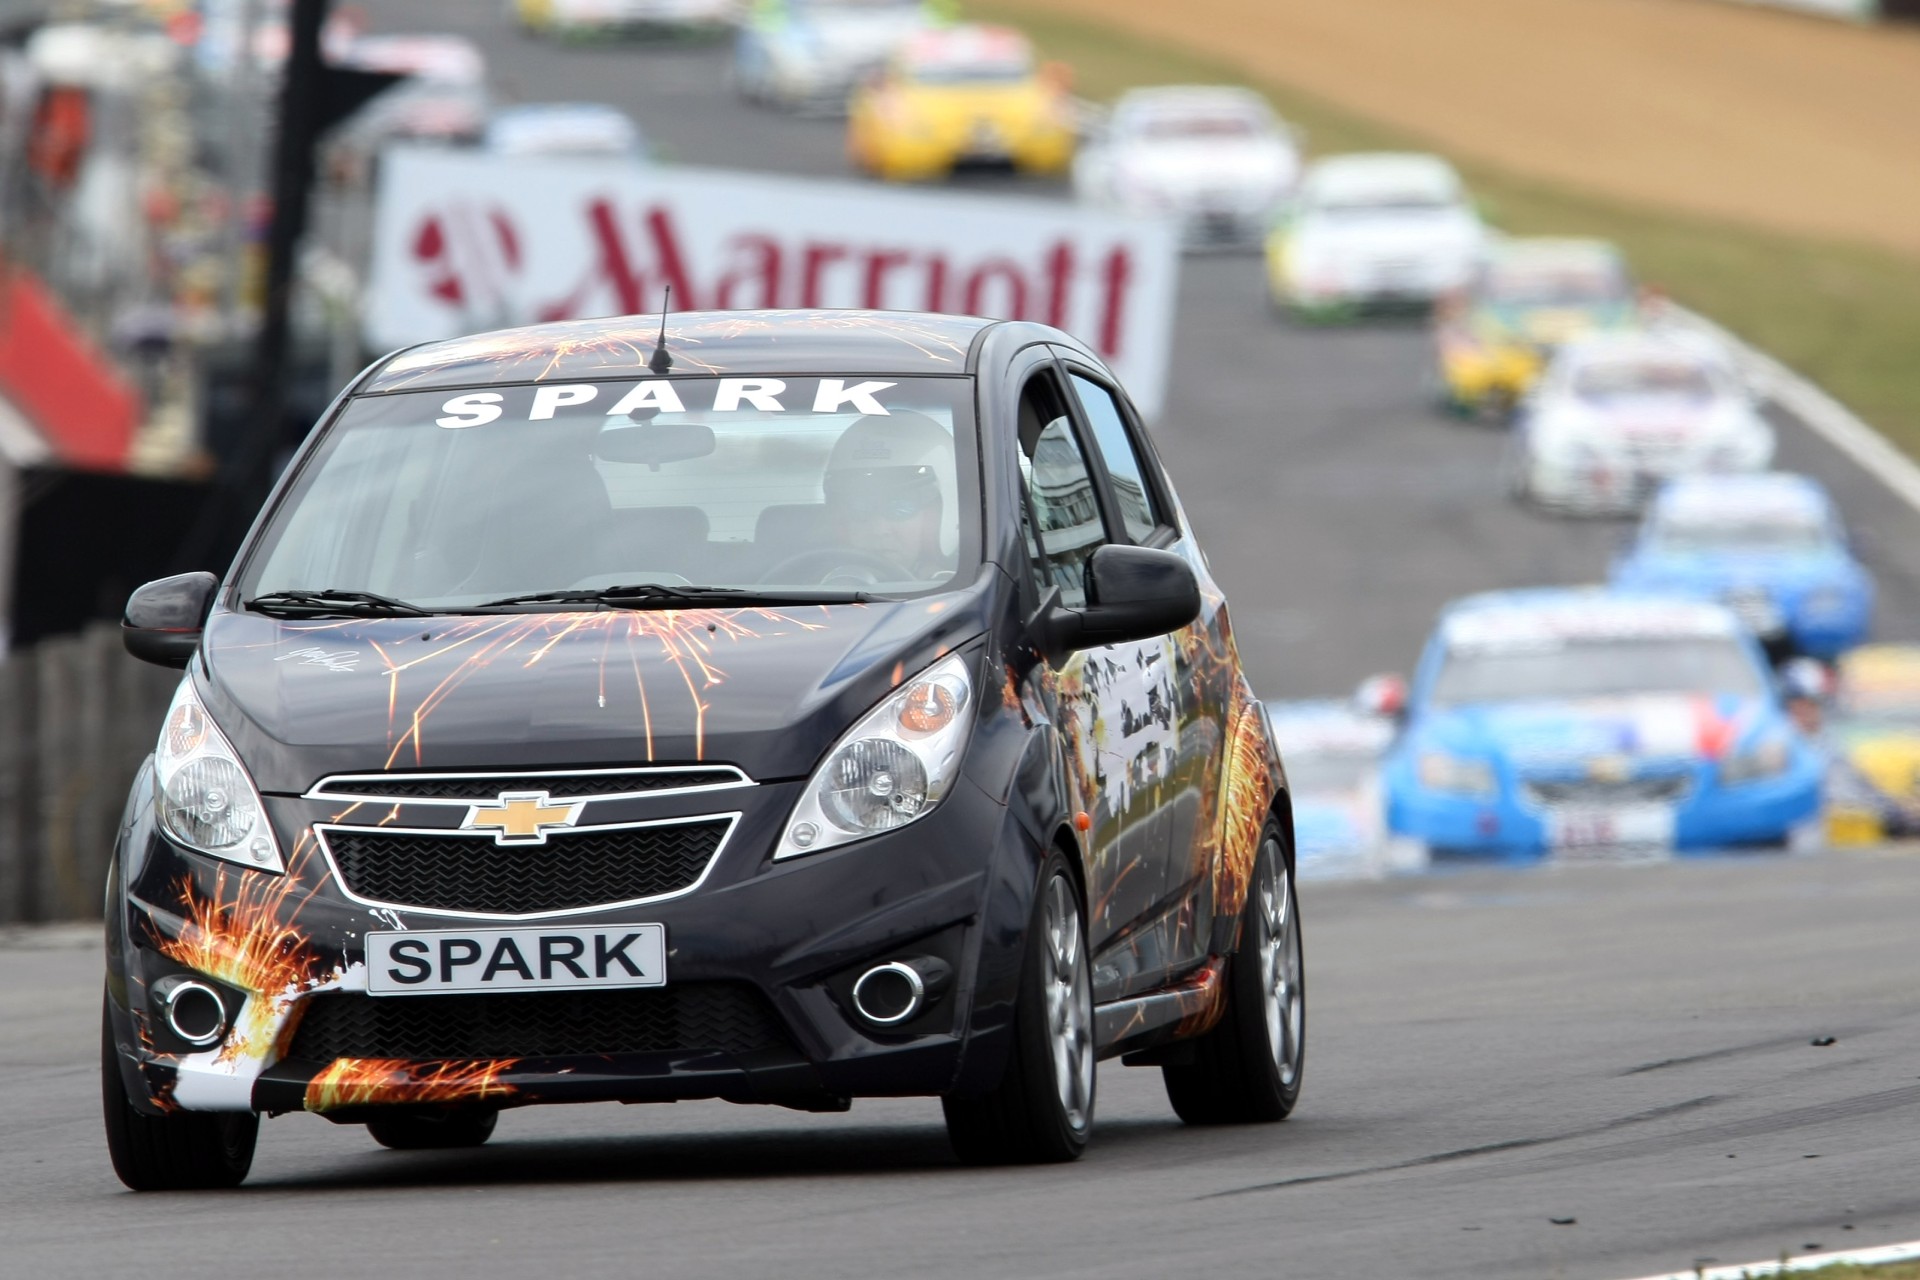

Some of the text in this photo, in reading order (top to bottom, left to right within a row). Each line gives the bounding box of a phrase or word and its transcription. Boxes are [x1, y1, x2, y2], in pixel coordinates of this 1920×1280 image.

[540, 196, 1137, 360] Marriott
[435, 378, 898, 429] SPARK
[387, 933, 645, 985] SPARK
